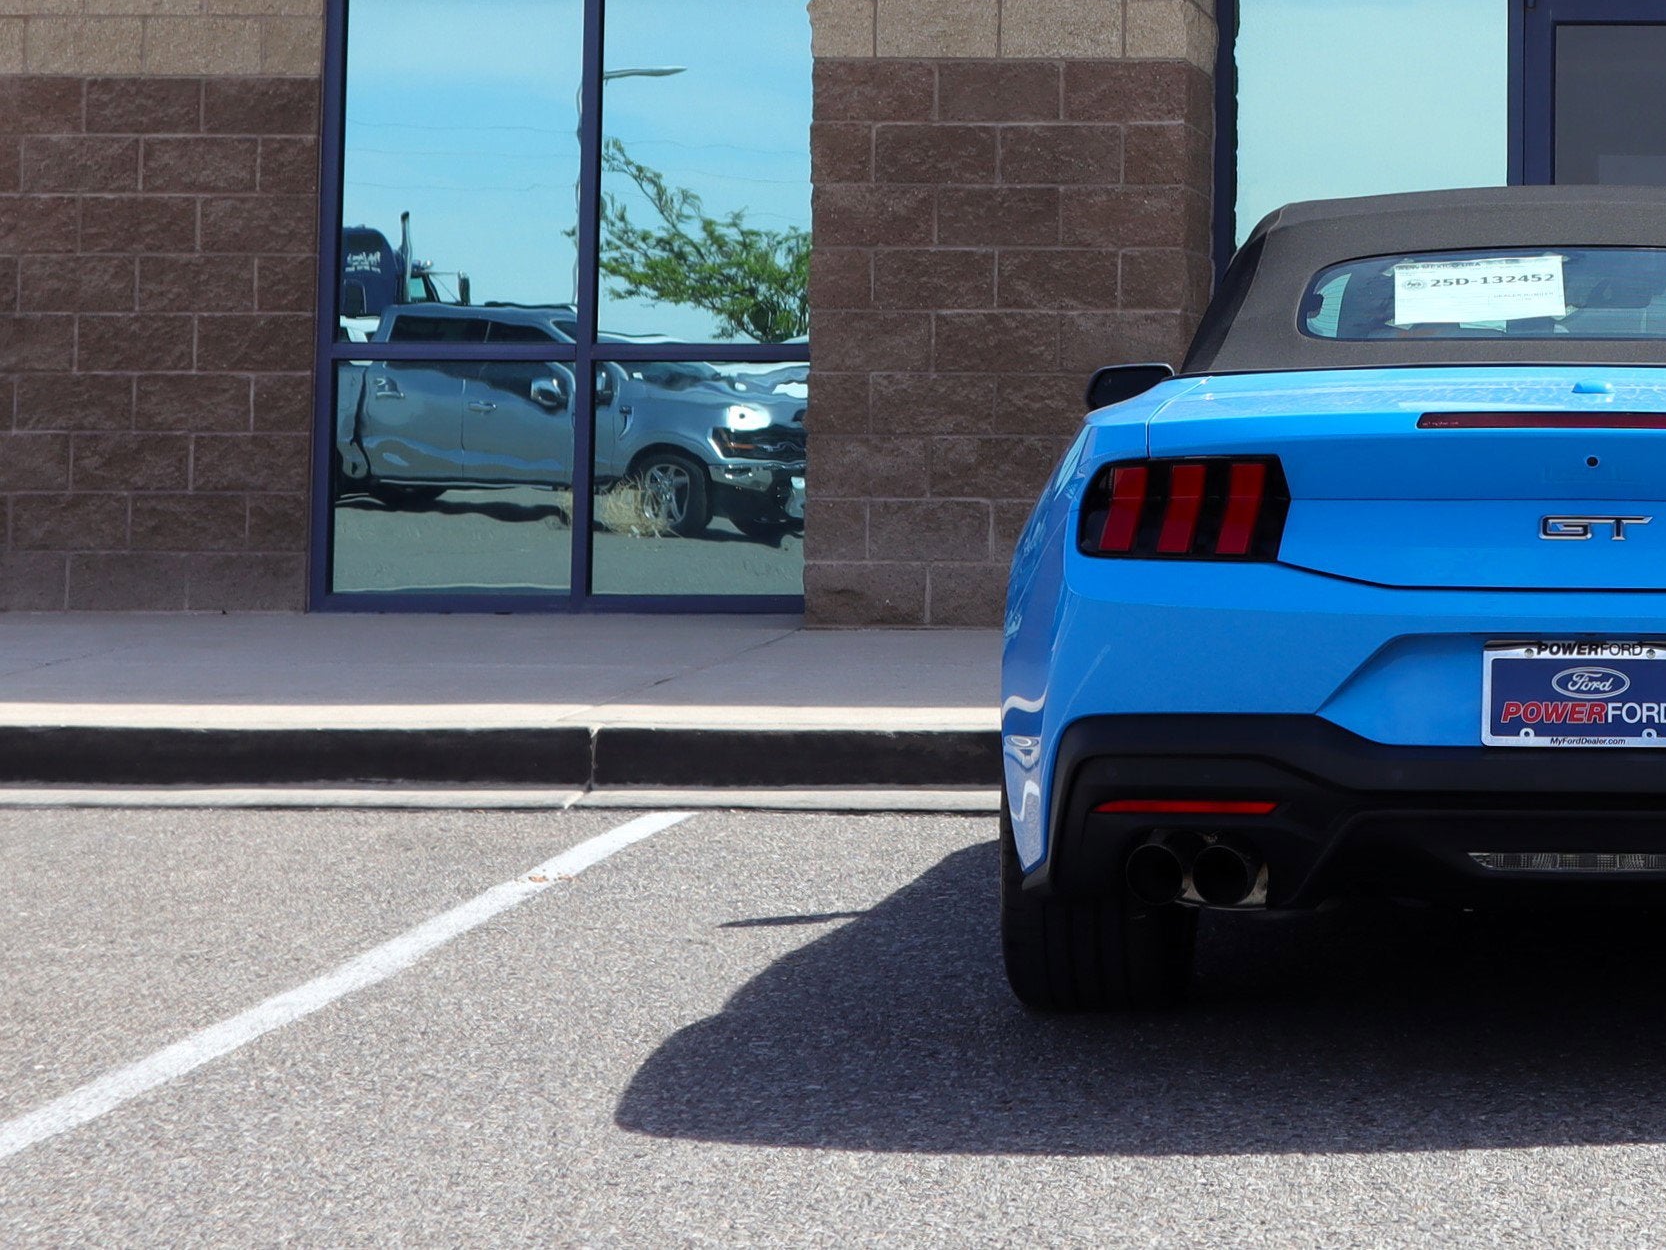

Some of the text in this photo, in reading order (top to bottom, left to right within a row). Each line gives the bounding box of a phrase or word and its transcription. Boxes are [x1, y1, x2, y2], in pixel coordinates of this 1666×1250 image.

[1430, 273, 1555, 288] 25D-132452
[1539, 515, 1653, 541] GT
[1536, 641, 1643, 657] POWERFORD
[1567, 672, 1614, 692] Ford
[1550, 737, 1626, 746] MyFordDealer.com
